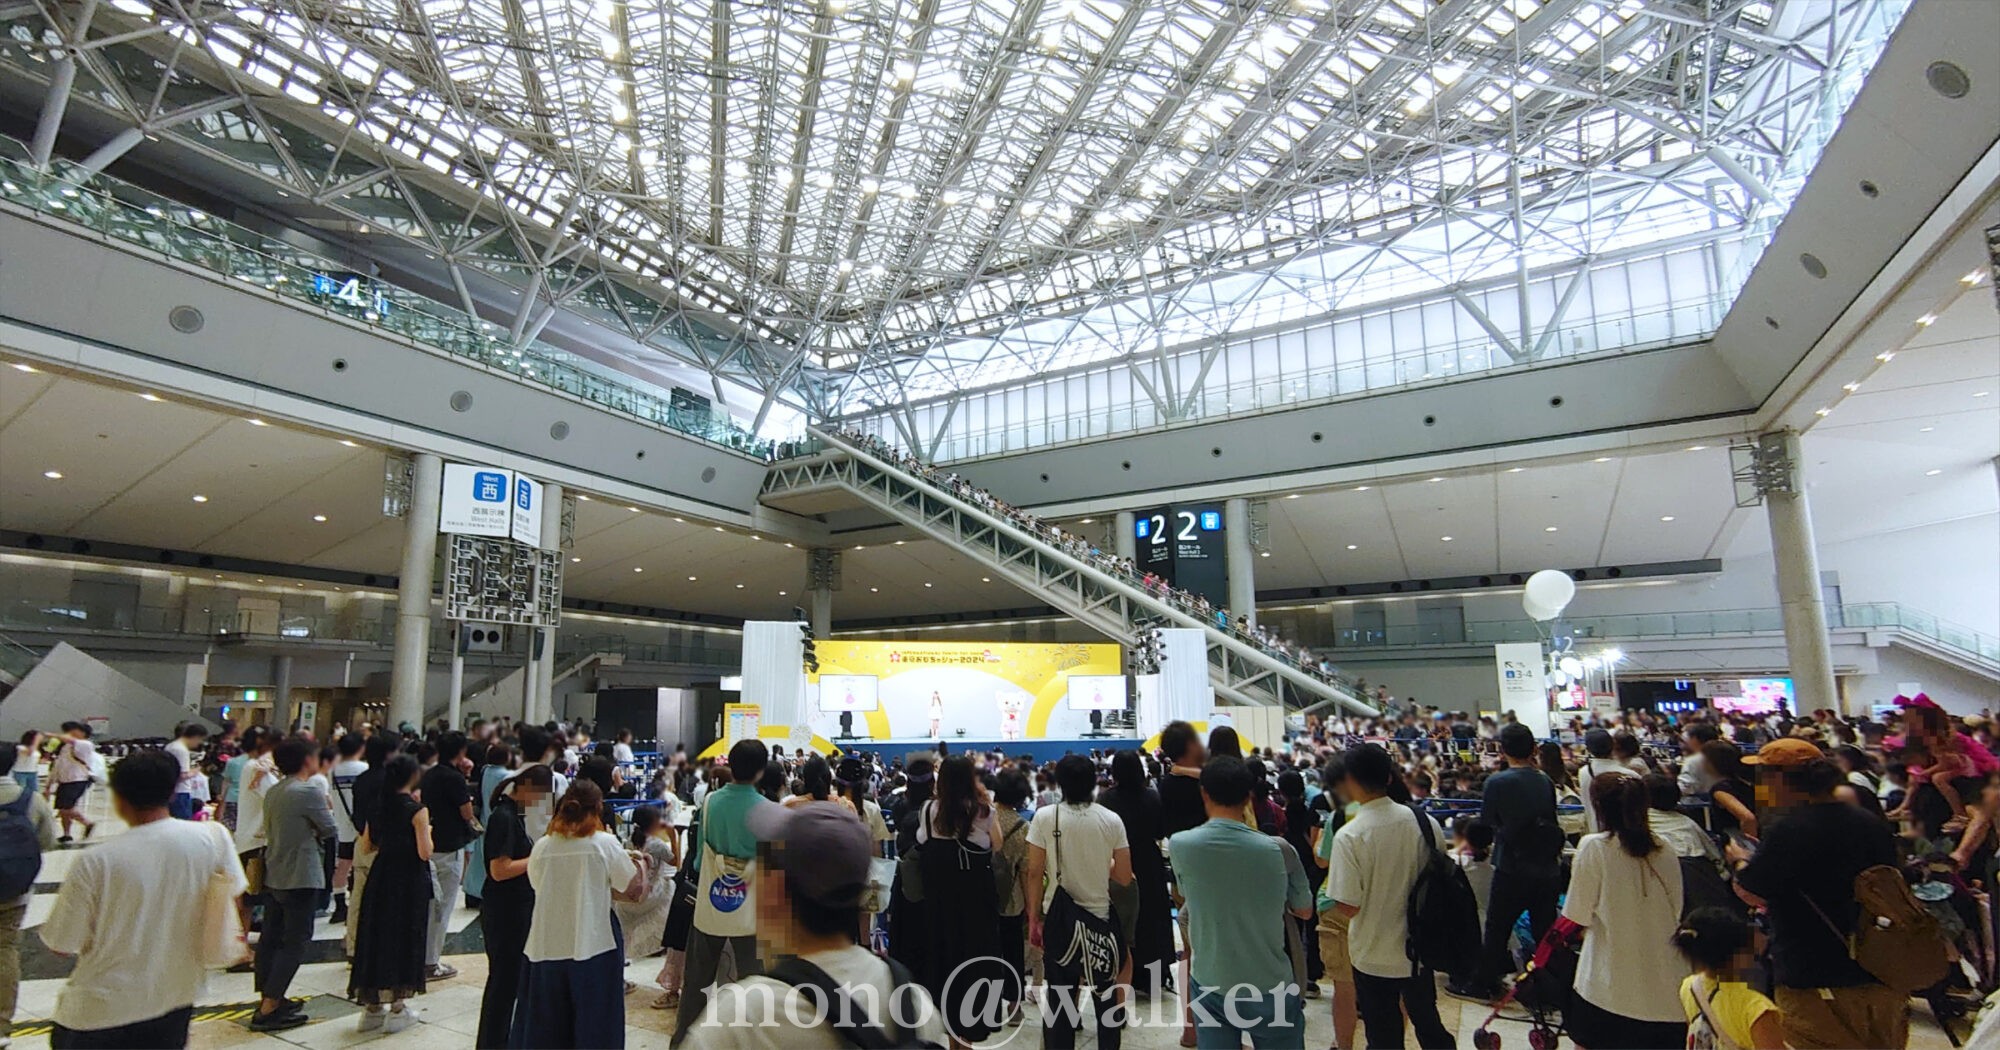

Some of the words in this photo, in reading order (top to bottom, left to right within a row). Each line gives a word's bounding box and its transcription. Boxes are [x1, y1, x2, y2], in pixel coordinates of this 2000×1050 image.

[338, 278, 363, 306] 4
[482, 475, 499, 483] West
[482, 483, 498, 500] 西
[1152, 515, 1166, 545] 2
[1178, 512, 1198, 541] 2
[1563, 636, 1574, 654] 2
[1516, 670, 1533, 679] 3-4
[712, 886, 745, 899] NASA
